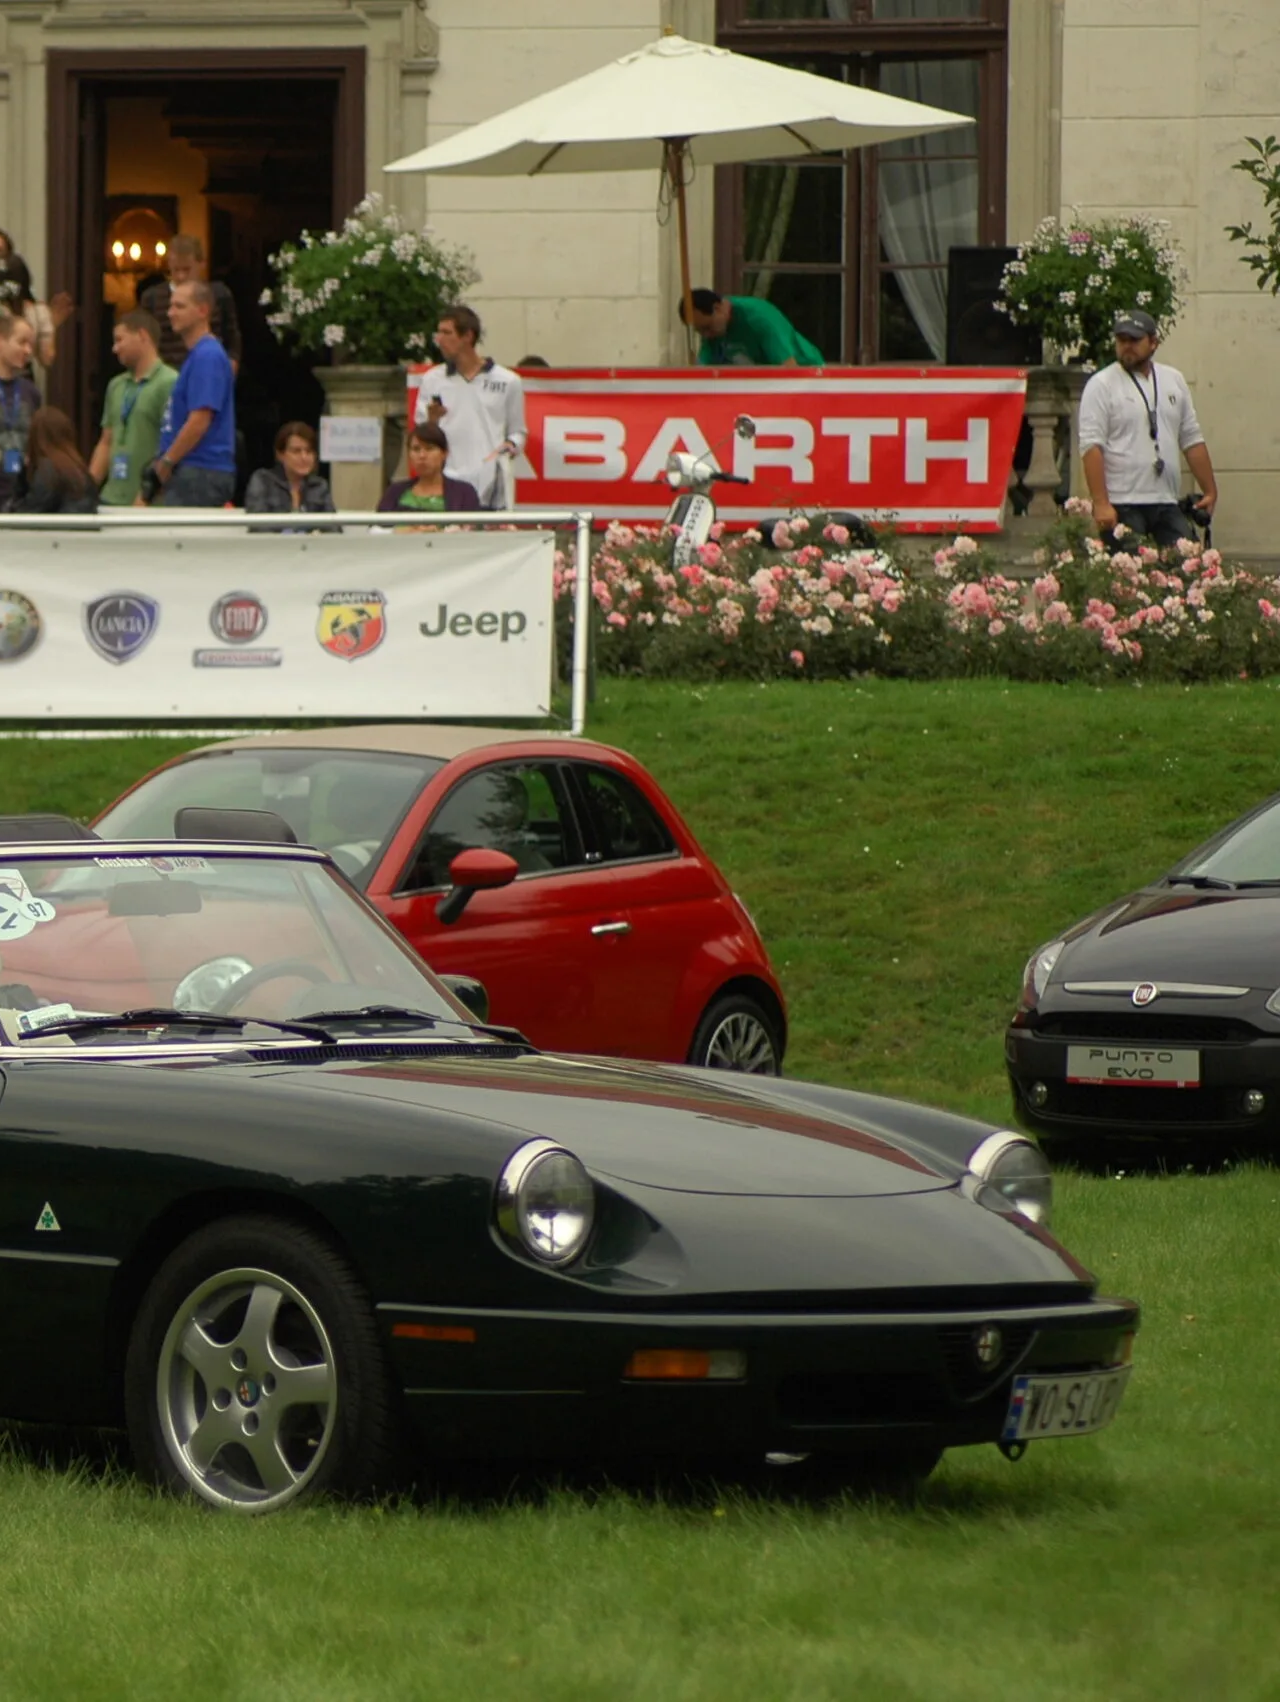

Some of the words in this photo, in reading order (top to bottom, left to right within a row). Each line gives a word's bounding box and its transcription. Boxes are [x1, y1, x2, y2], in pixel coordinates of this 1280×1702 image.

[515, 415, 991, 484] BARTH
[99, 615, 144, 633] LANCIA
[225, 606, 257, 631] FIAT
[419, 603, 527, 642] Jeep
[1089, 1049, 1173, 1064] PUNTO
[1107, 1067, 1155, 1080] EVO
